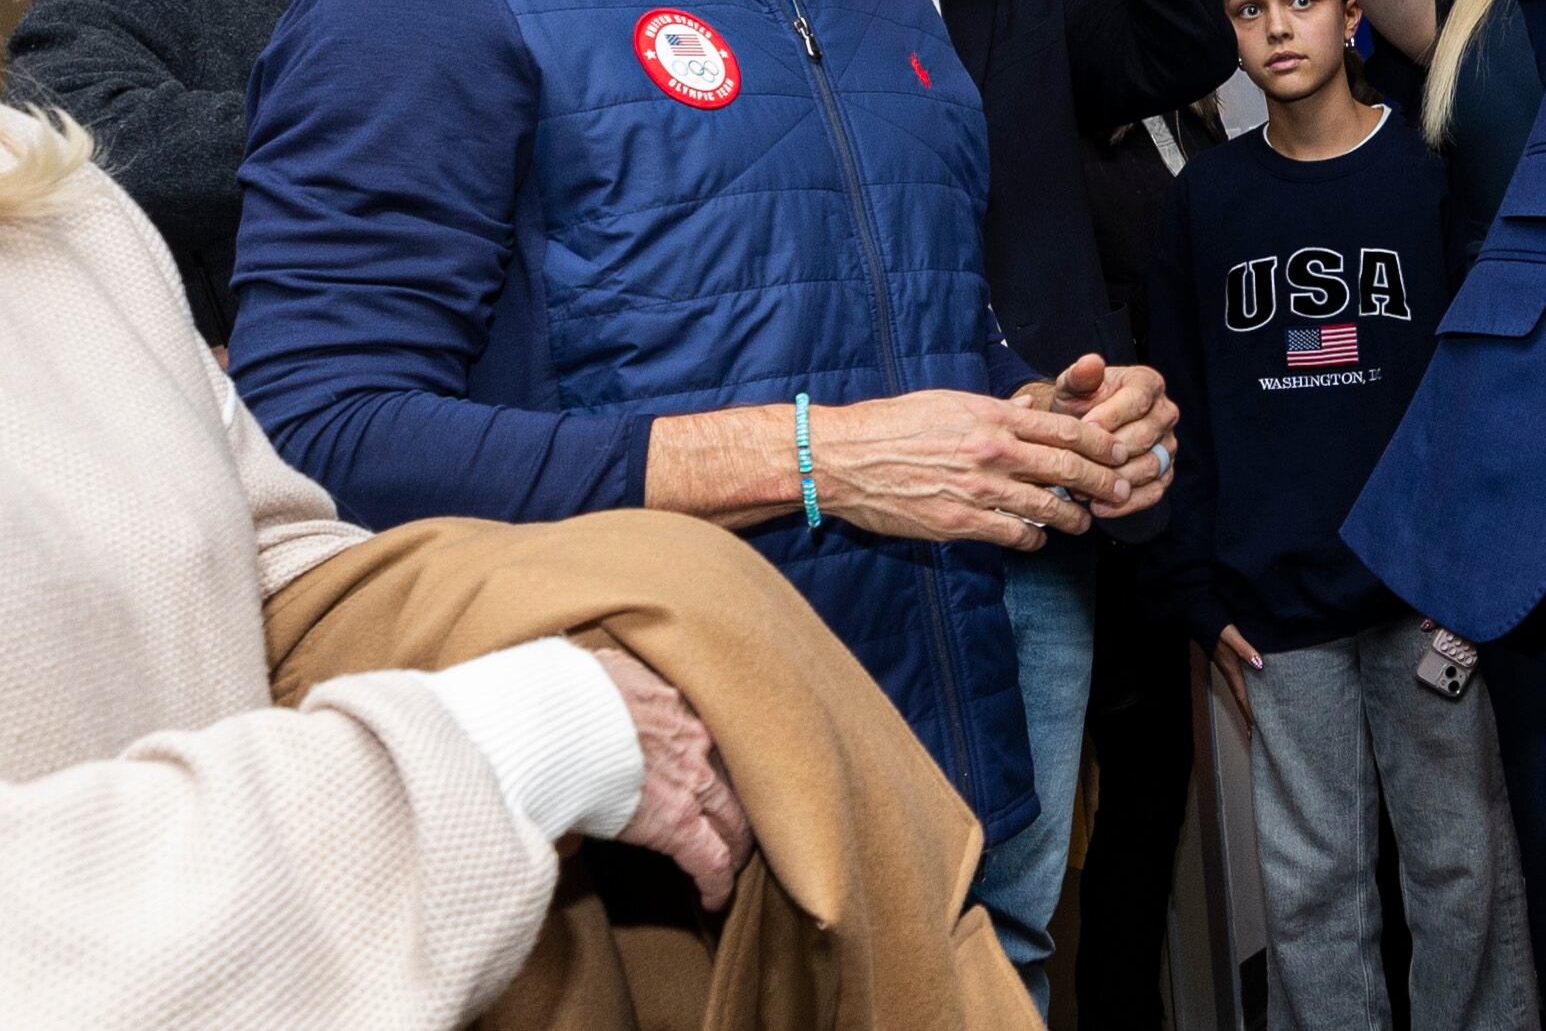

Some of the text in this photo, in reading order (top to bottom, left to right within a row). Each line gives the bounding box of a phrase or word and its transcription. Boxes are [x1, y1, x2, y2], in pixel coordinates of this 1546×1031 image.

[645, 14, 712, 39] UNITED STATES
[668, 78, 734, 101] OLYMPIC TEAM
[1225, 247, 1412, 332] USA
